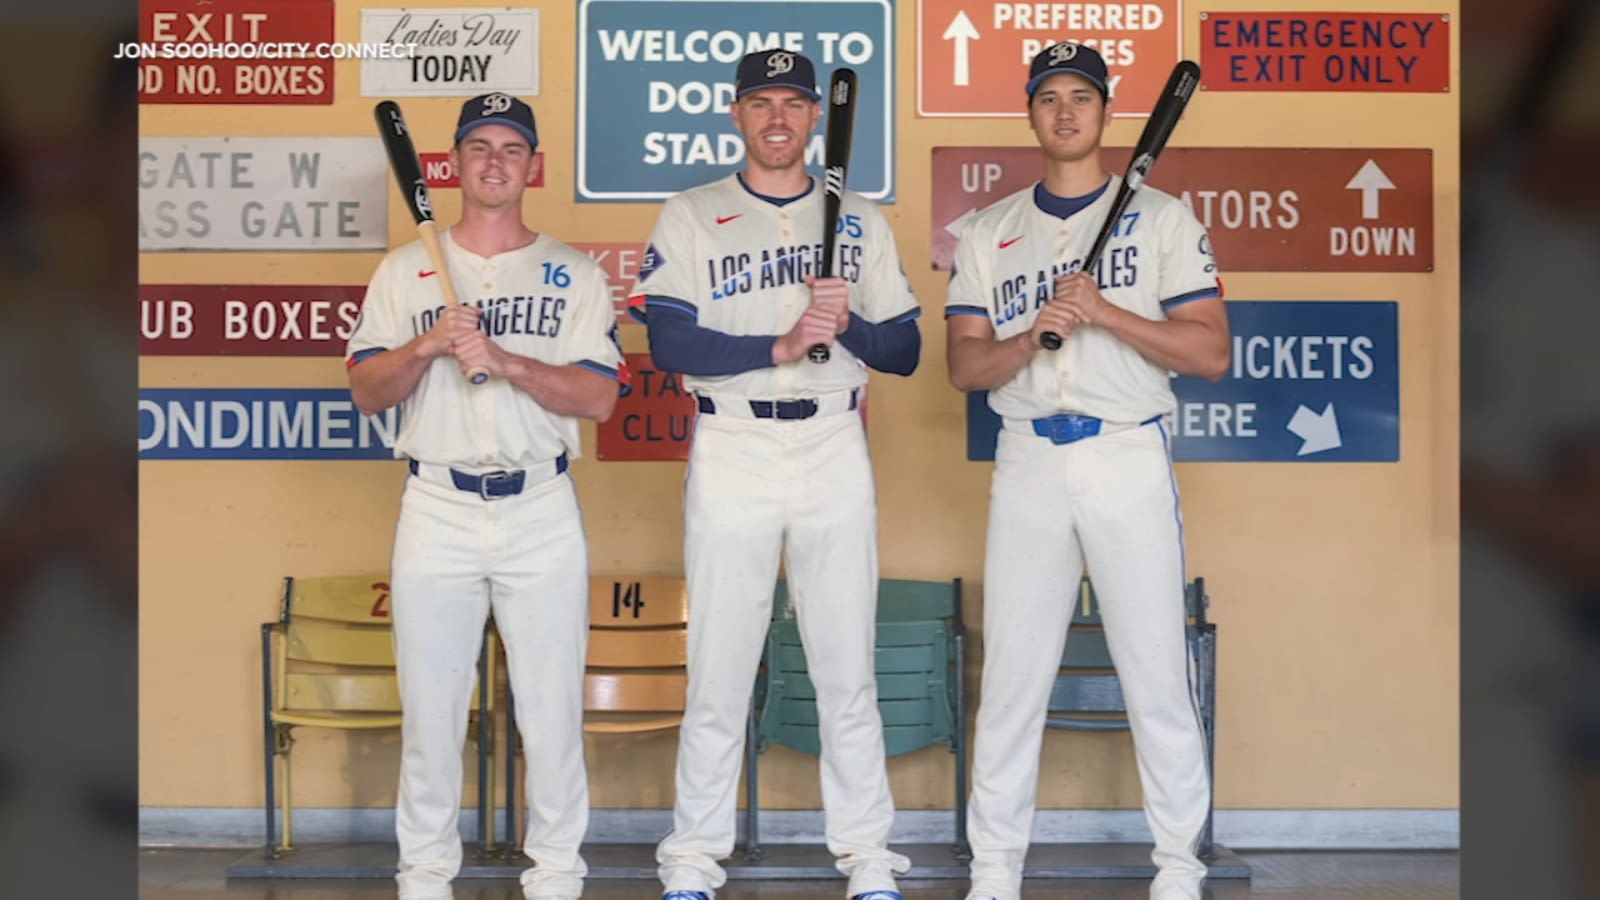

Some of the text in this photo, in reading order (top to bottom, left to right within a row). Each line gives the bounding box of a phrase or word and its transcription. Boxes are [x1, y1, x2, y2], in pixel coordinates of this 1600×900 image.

[153, 13, 268, 42] EXIT
[385, 13, 521, 55] Ladies Day
[994, 3, 1163, 30] PREFERRED
[1214, 20, 1434, 48] EMERGENCY
[598, 29, 874, 64] WELCOME TO
[177, 65, 222, 94] NO.
[235, 65, 325, 95] BOXES
[408, 55, 492, 82] TODAY
[1230, 54, 1418, 83] EXIT ONLY
[138, 152, 320, 189] GATE W
[961, 163, 1003, 193] UP
[139, 201, 361, 238] SS GATE
[1330, 226, 1416, 256] DOWN
[541, 262, 571, 289] 16
[708, 243, 863, 300] LOS ANGEES
[462, 296, 567, 338] NGELES
[992, 274, 1026, 326] LOS
[140, 300, 360, 340] UB BOXES
[1233, 336, 1374, 379] ICKETS
[623, 414, 689, 442] CLU
[370, 582, 391, 617] 2
[612, 582, 645, 619] 14
